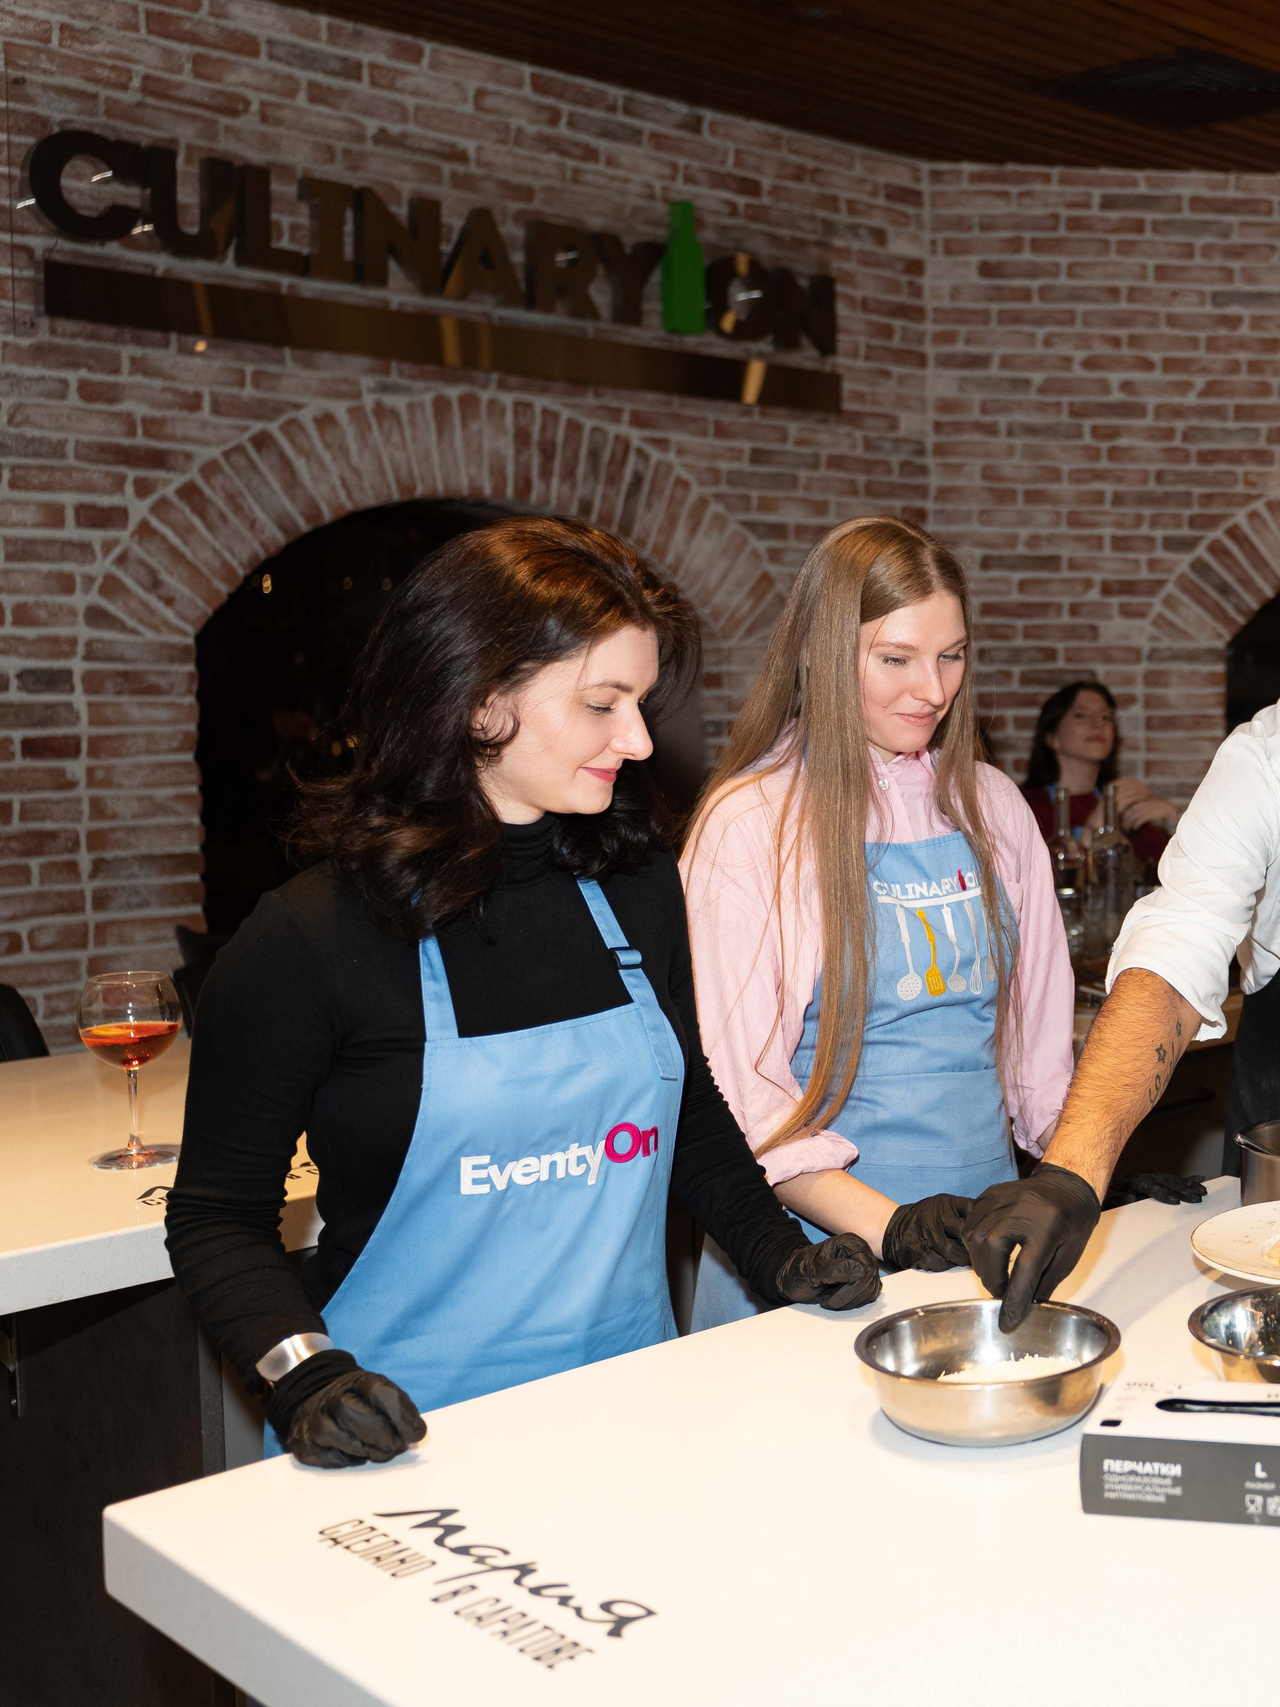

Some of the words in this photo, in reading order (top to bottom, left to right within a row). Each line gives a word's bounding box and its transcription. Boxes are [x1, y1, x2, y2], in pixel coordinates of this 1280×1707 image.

[459, 1121, 659, 1196] EventyOn
[1103, 1458, 1182, 1477] ПЕРЧАТКИ
[1254, 1461, 1268, 1479] L
[318, 1519, 437, 1579] СДЕЛАНО
[430, 1584, 479, 1604] В
[453, 1597, 596, 1671] САРАТОВЕ
